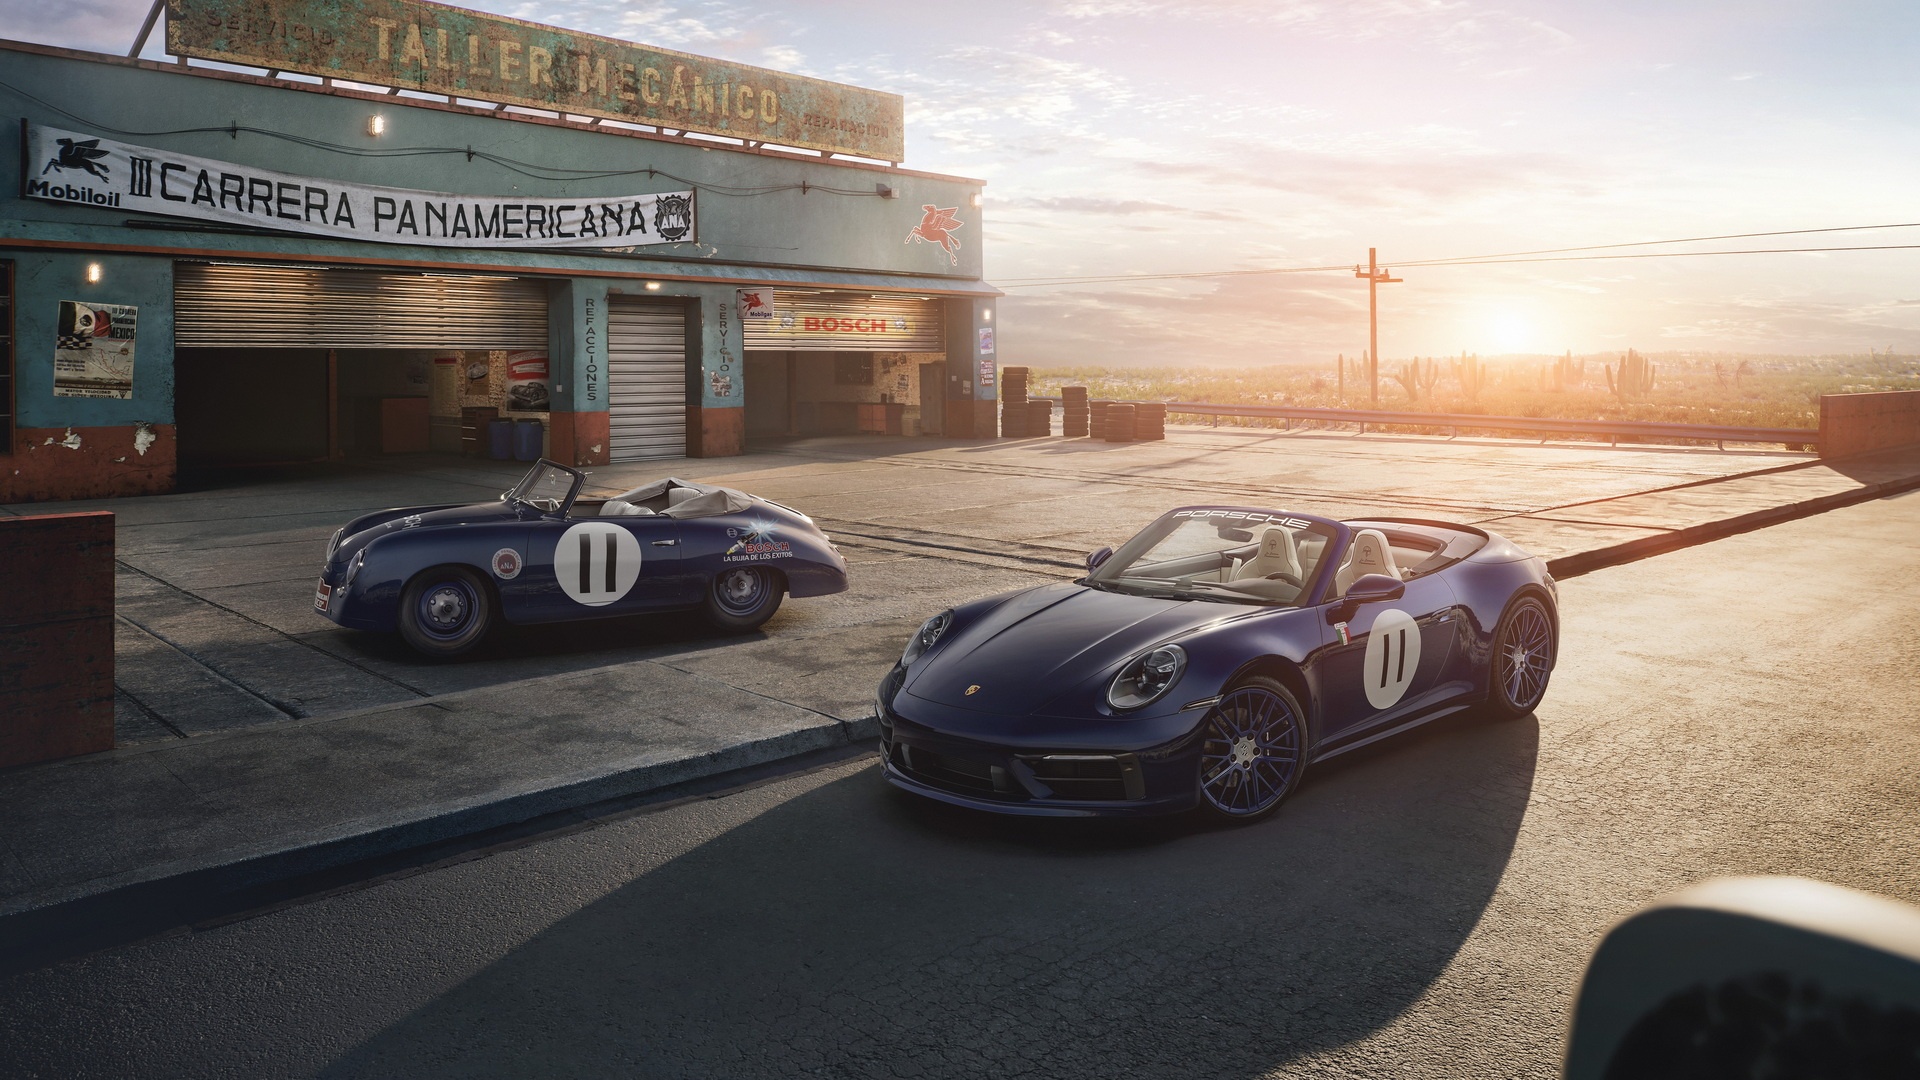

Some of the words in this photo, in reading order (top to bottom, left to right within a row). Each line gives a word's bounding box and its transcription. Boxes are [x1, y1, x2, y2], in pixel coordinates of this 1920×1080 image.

[206, 11, 334, 45] SERVICIO
[370, 16, 553, 86] TALLER
[578, 54, 778, 124] MECÁNICO
[26, 179, 120, 207] Mobiloil
[129, 156, 152, 198] III
[160, 162, 356, 229] CARRERA
[373, 196, 648, 238] PANAMERICANA
[660, 214, 686, 229] ANA
[108, 327, 135, 339] MEXICO
[719, 303, 730, 372] SERVICIO
[804, 317, 887, 333] BOSCH
[585, 298, 598, 401] REFACCIONES
[1172, 510, 1312, 529] PORSCHE
[579, 533, 617, 593] 11
[746, 542, 790, 554] BOSCH
[760, 552, 771, 560] LOS
[772, 551, 793, 559] EXITOS
[1380, 629, 1405, 688] 11
